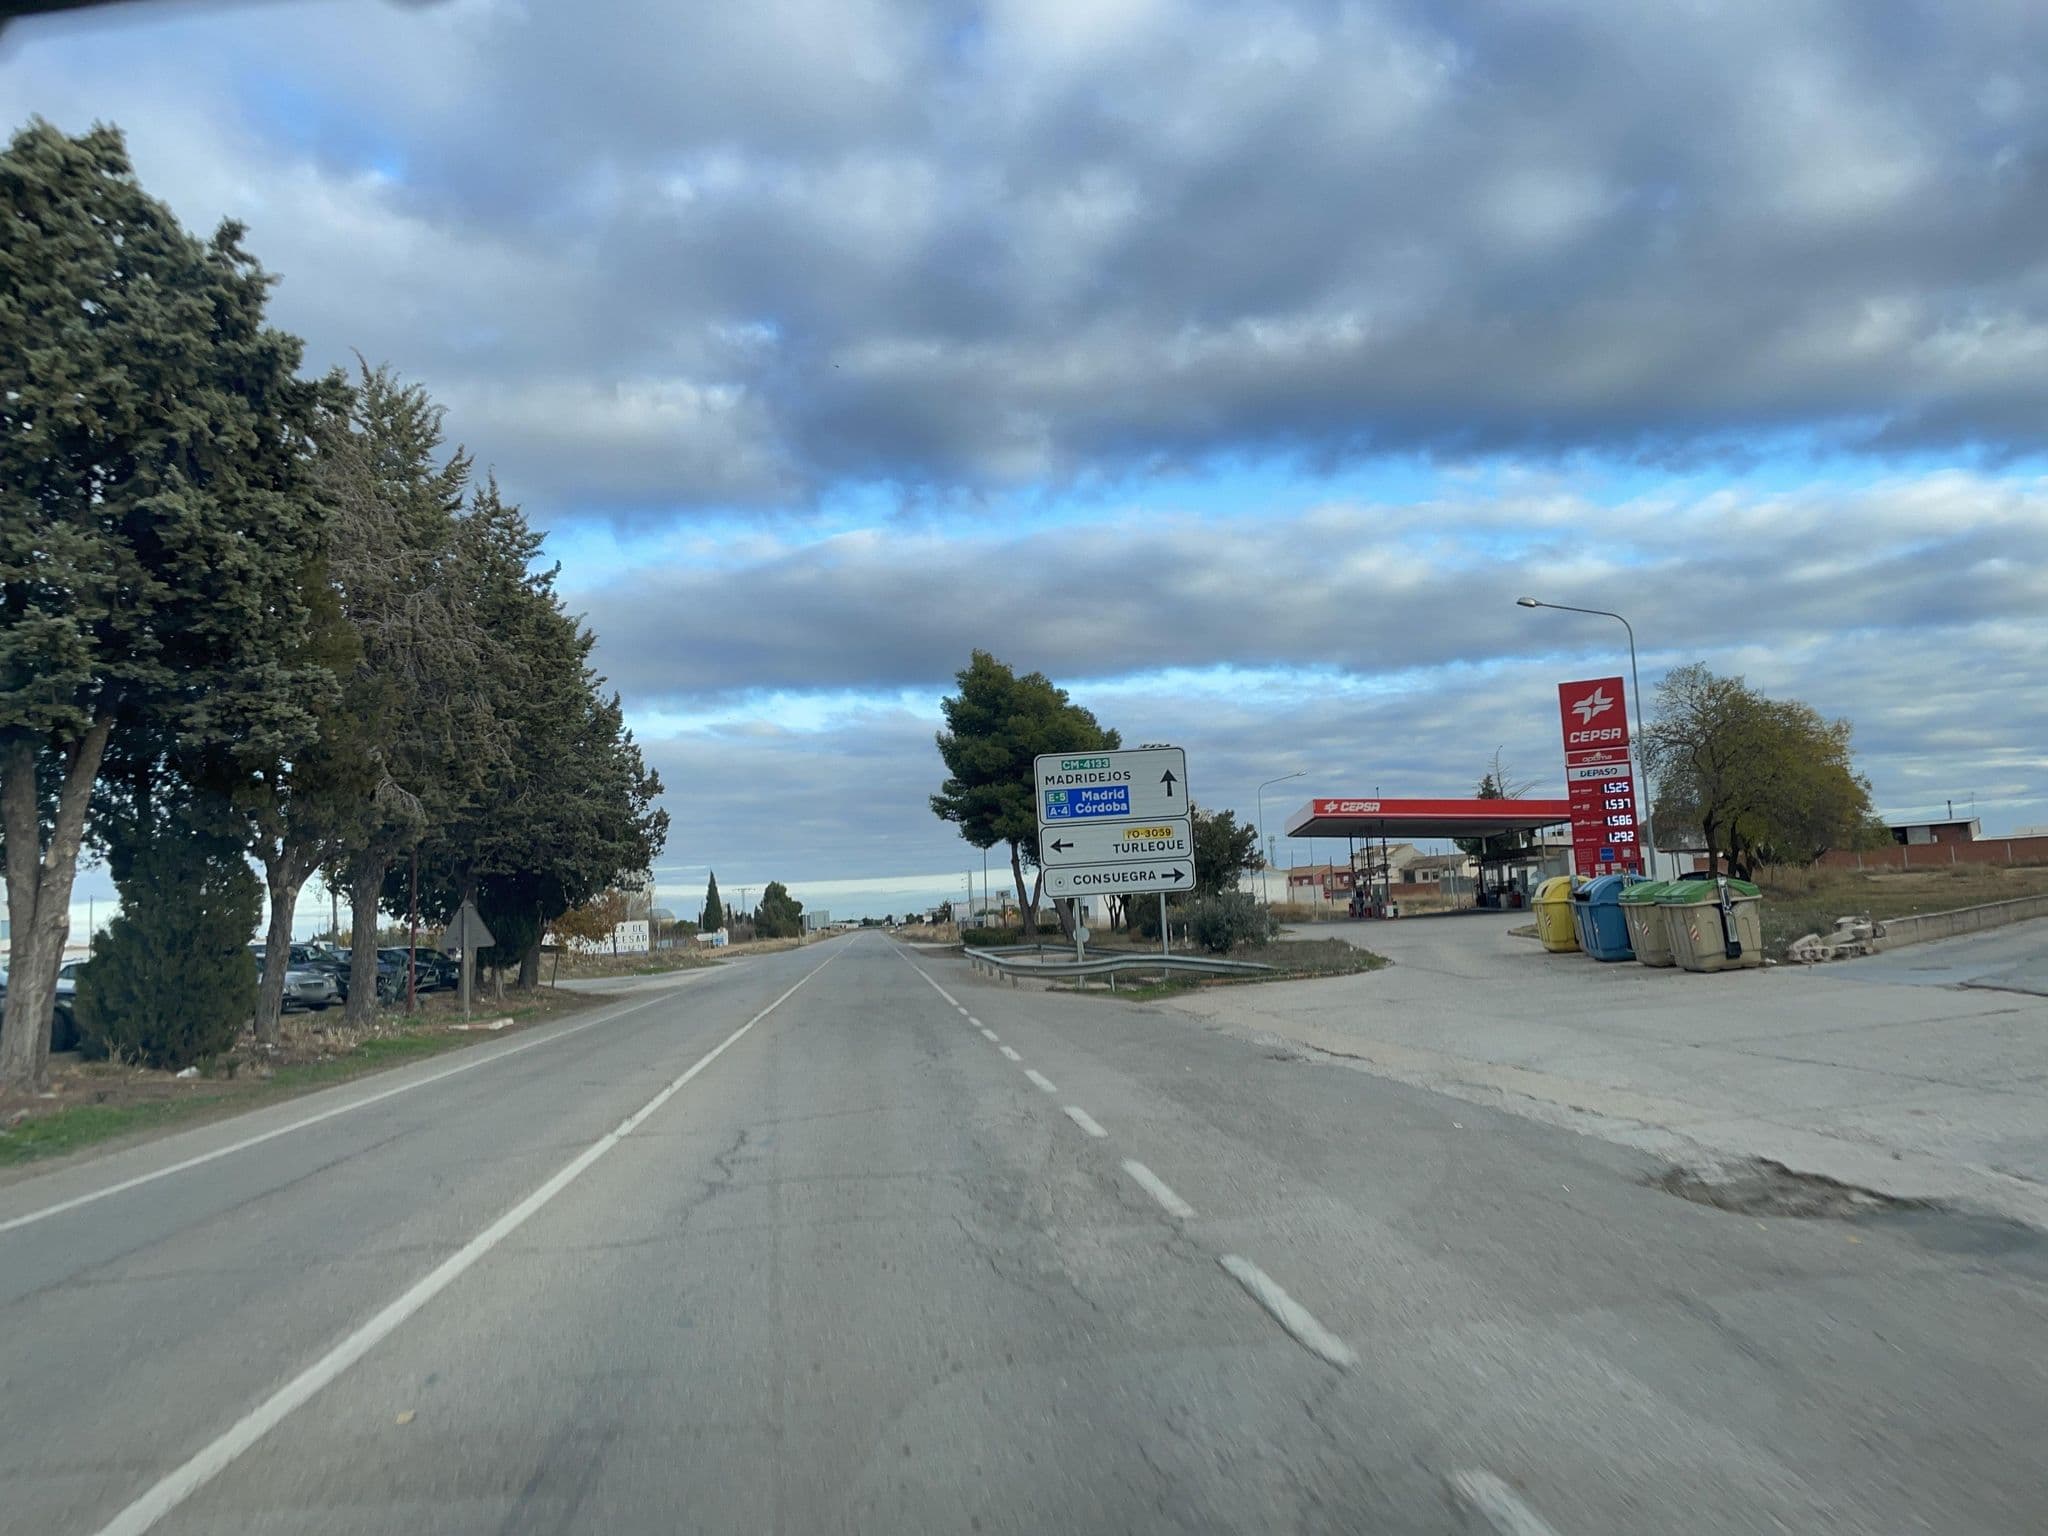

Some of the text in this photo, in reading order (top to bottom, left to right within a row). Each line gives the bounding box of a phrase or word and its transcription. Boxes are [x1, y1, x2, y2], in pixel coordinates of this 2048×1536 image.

[1569, 728, 1622, 743] CEPSA
[1062, 758, 1109, 770] CM-4133
[1045, 771, 1131, 786] MADRIDEJOS
[1580, 768, 1618, 777] DEPASO
[1603, 782, 1629, 793] 1.525
[1049, 789, 1125, 802] E-5 Madrid
[1050, 801, 1128, 815] A-4 Córdoba
[1340, 802, 1380, 812] CEPSA
[1605, 798, 1631, 810] 1.537
[1607, 814, 1632, 826] 1.586
[1609, 831, 1634, 843] 1.292
[1113, 840, 1185, 854] TURLEQUE
[1073, 870, 1157, 885] CONSUEGRA
